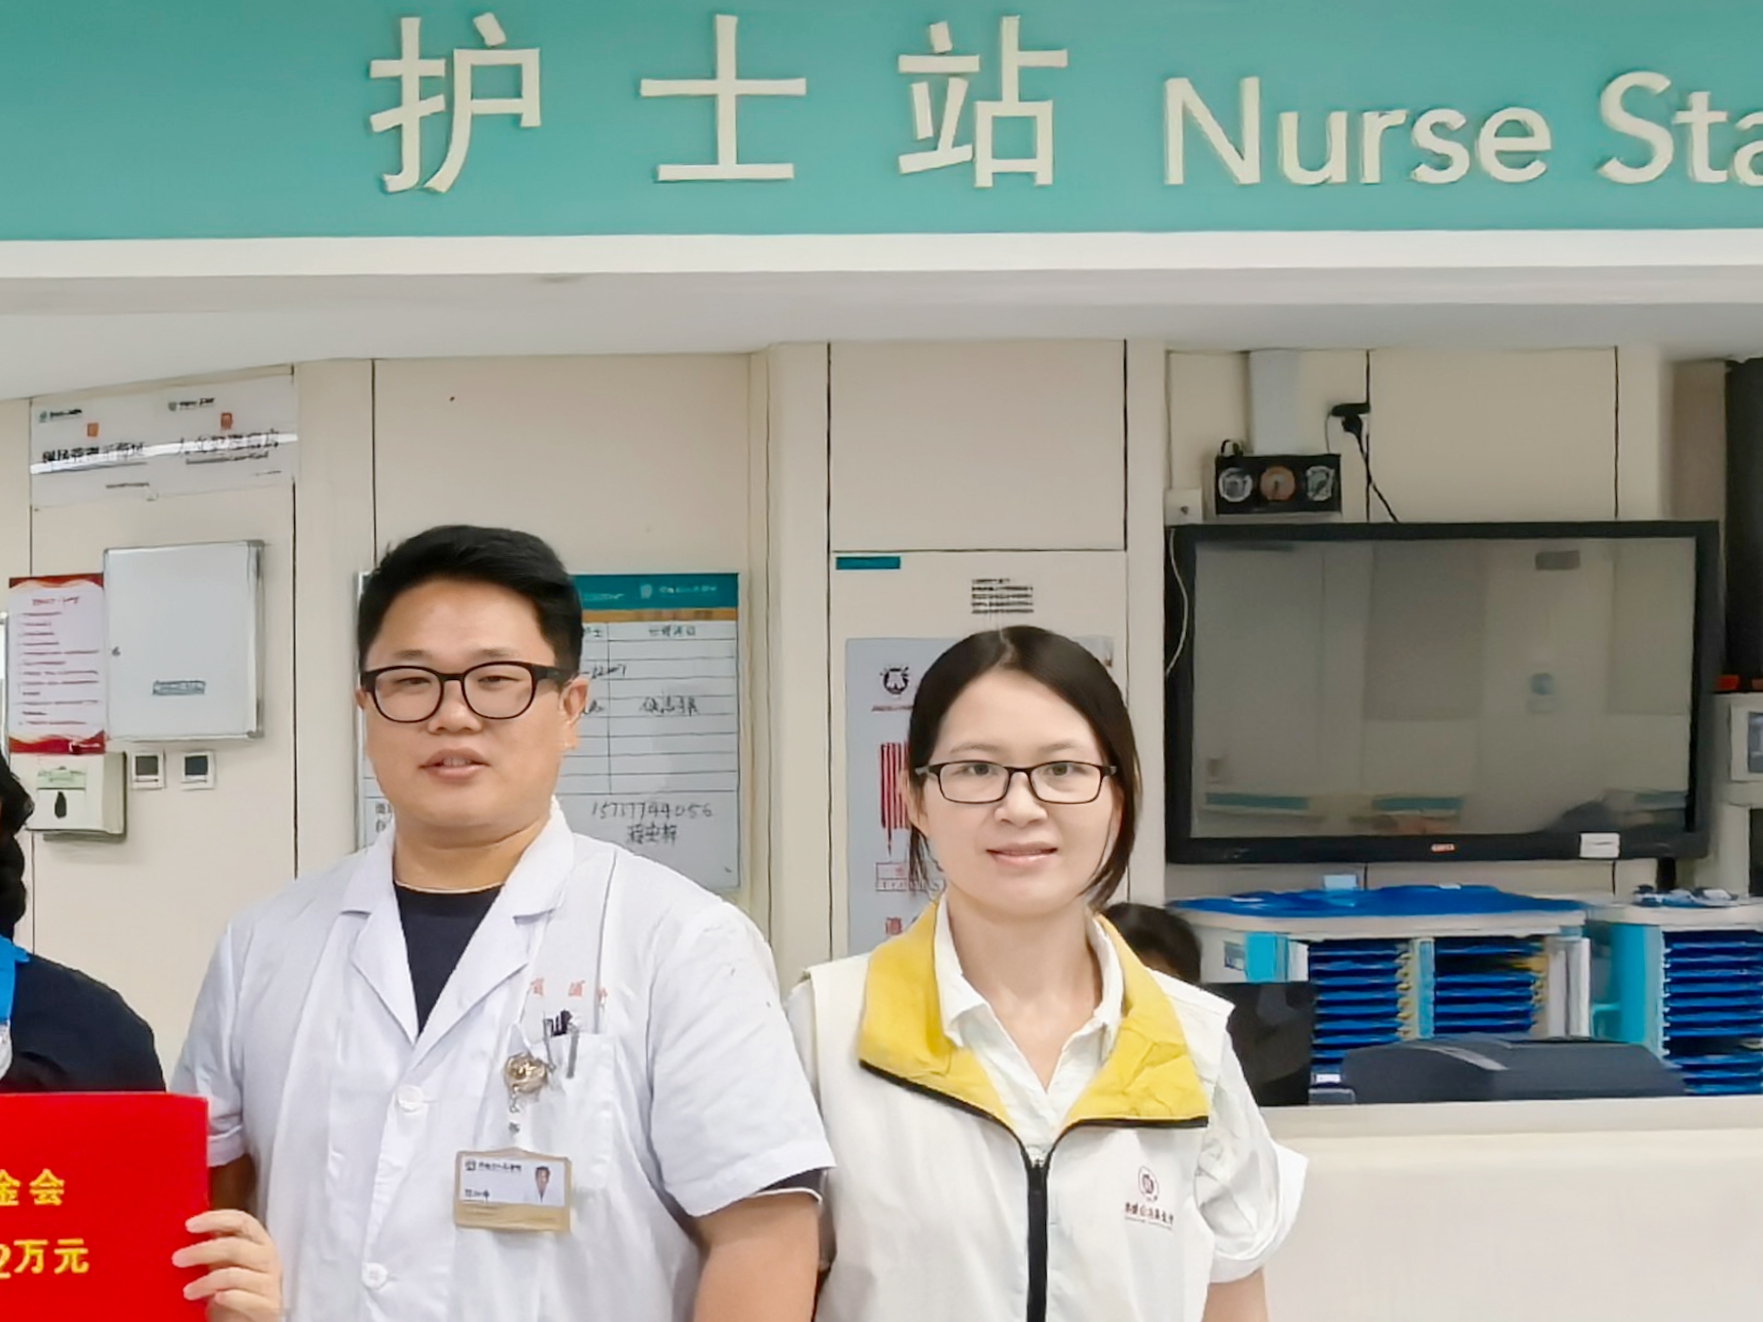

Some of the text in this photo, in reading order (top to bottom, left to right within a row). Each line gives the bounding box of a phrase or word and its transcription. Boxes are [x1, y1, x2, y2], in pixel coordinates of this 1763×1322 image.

[369, 13, 1068, 193] 护士站
[1163, 75, 1549, 186] Nurse
